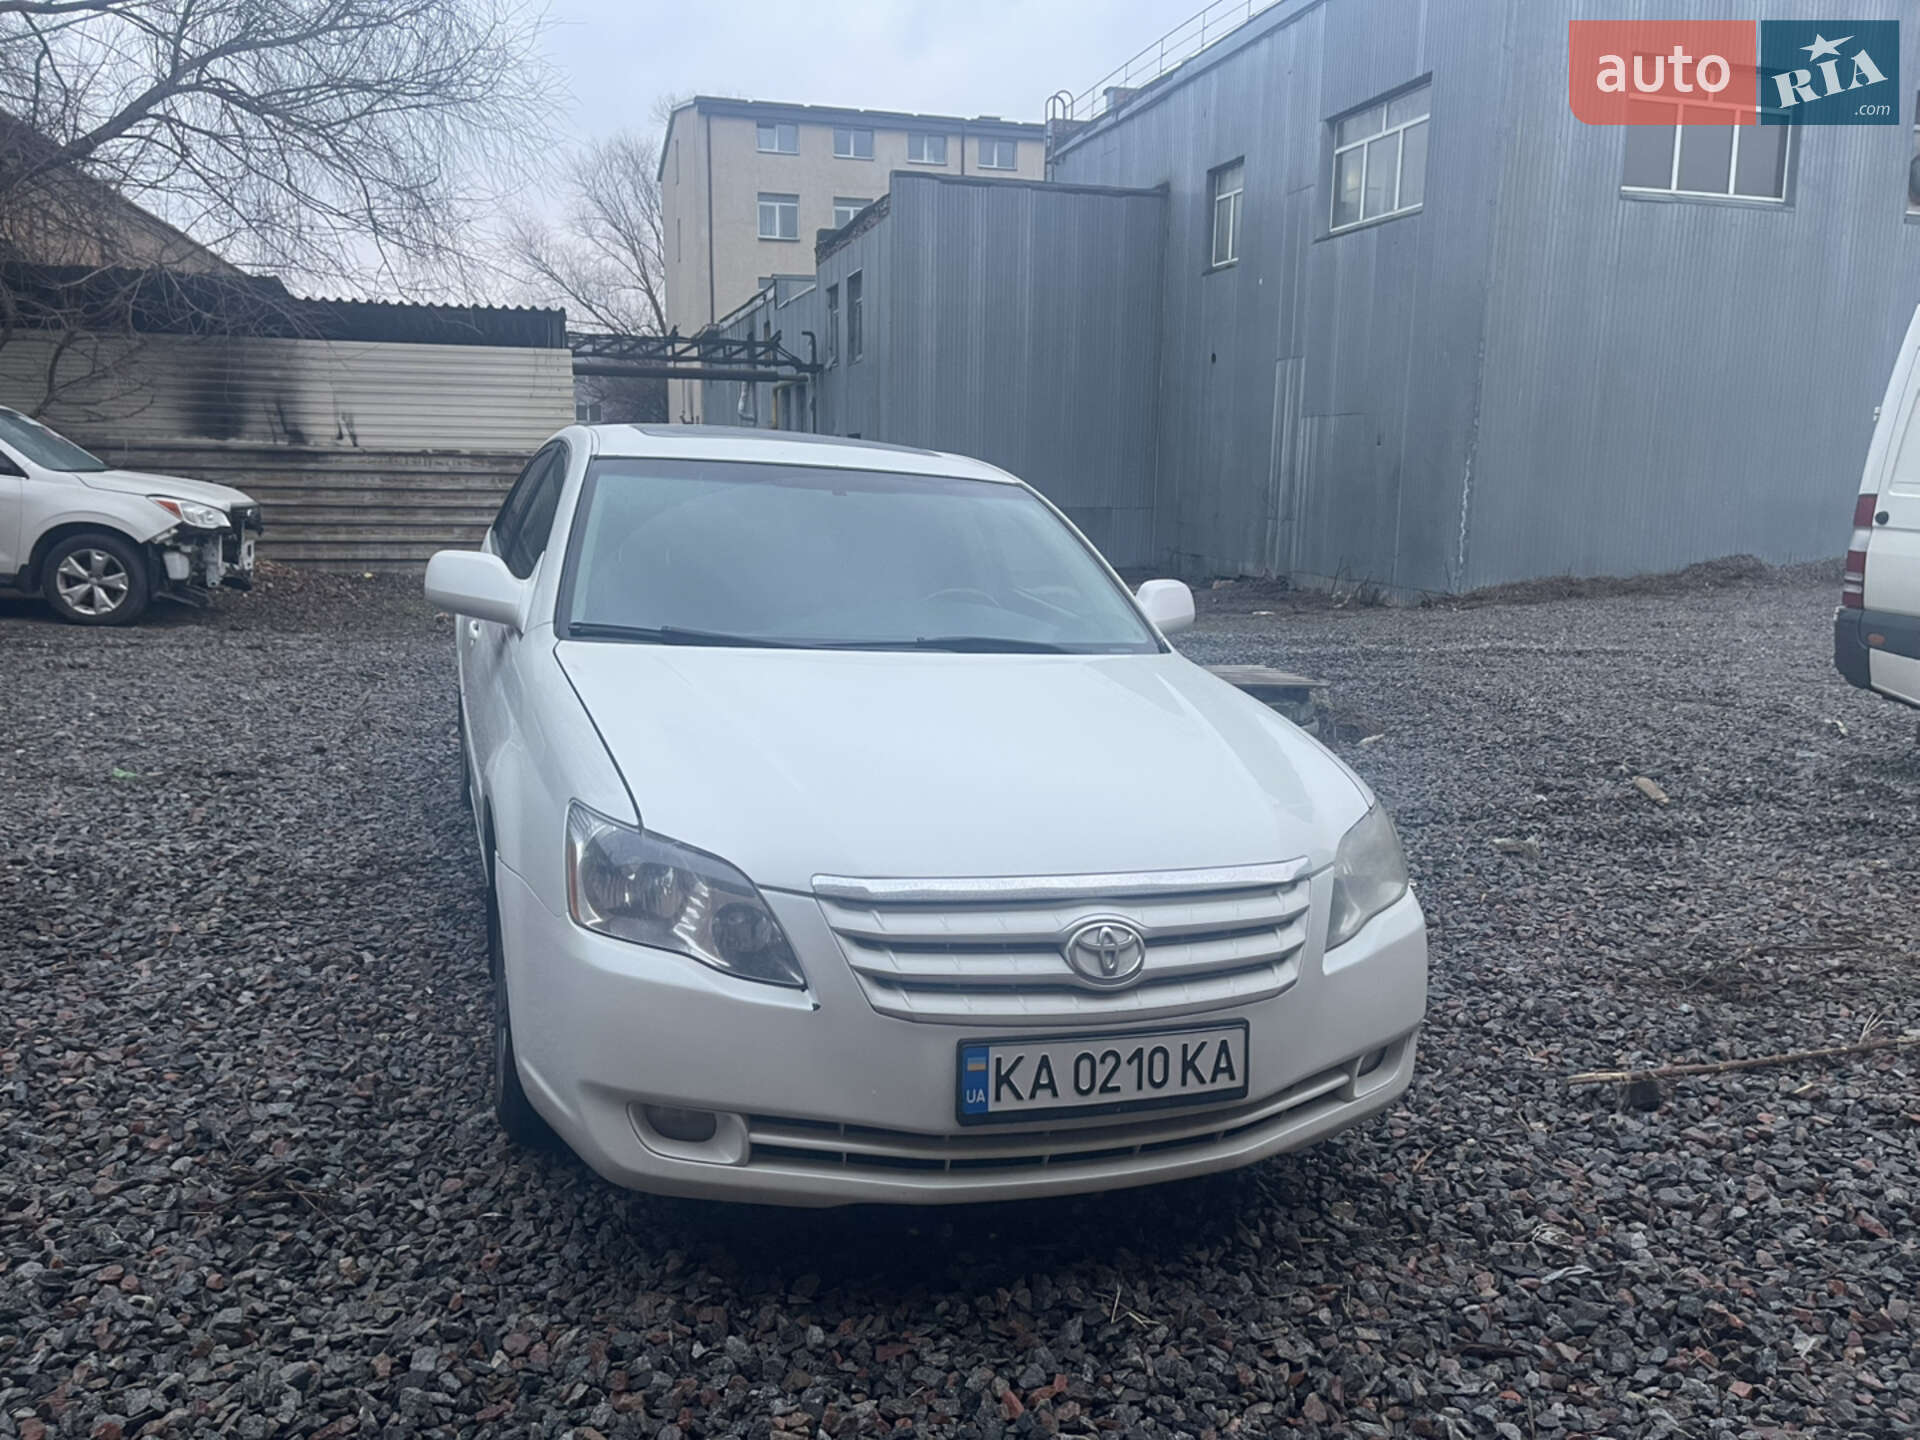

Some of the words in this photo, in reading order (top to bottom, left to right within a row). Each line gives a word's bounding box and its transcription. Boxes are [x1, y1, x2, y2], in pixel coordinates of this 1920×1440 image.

[994, 1054, 1059, 1103] KA
[1073, 1045, 1171, 1097] 0210
[1180, 1039, 1237, 1087] KA
[965, 1088, 987, 1105] UA
